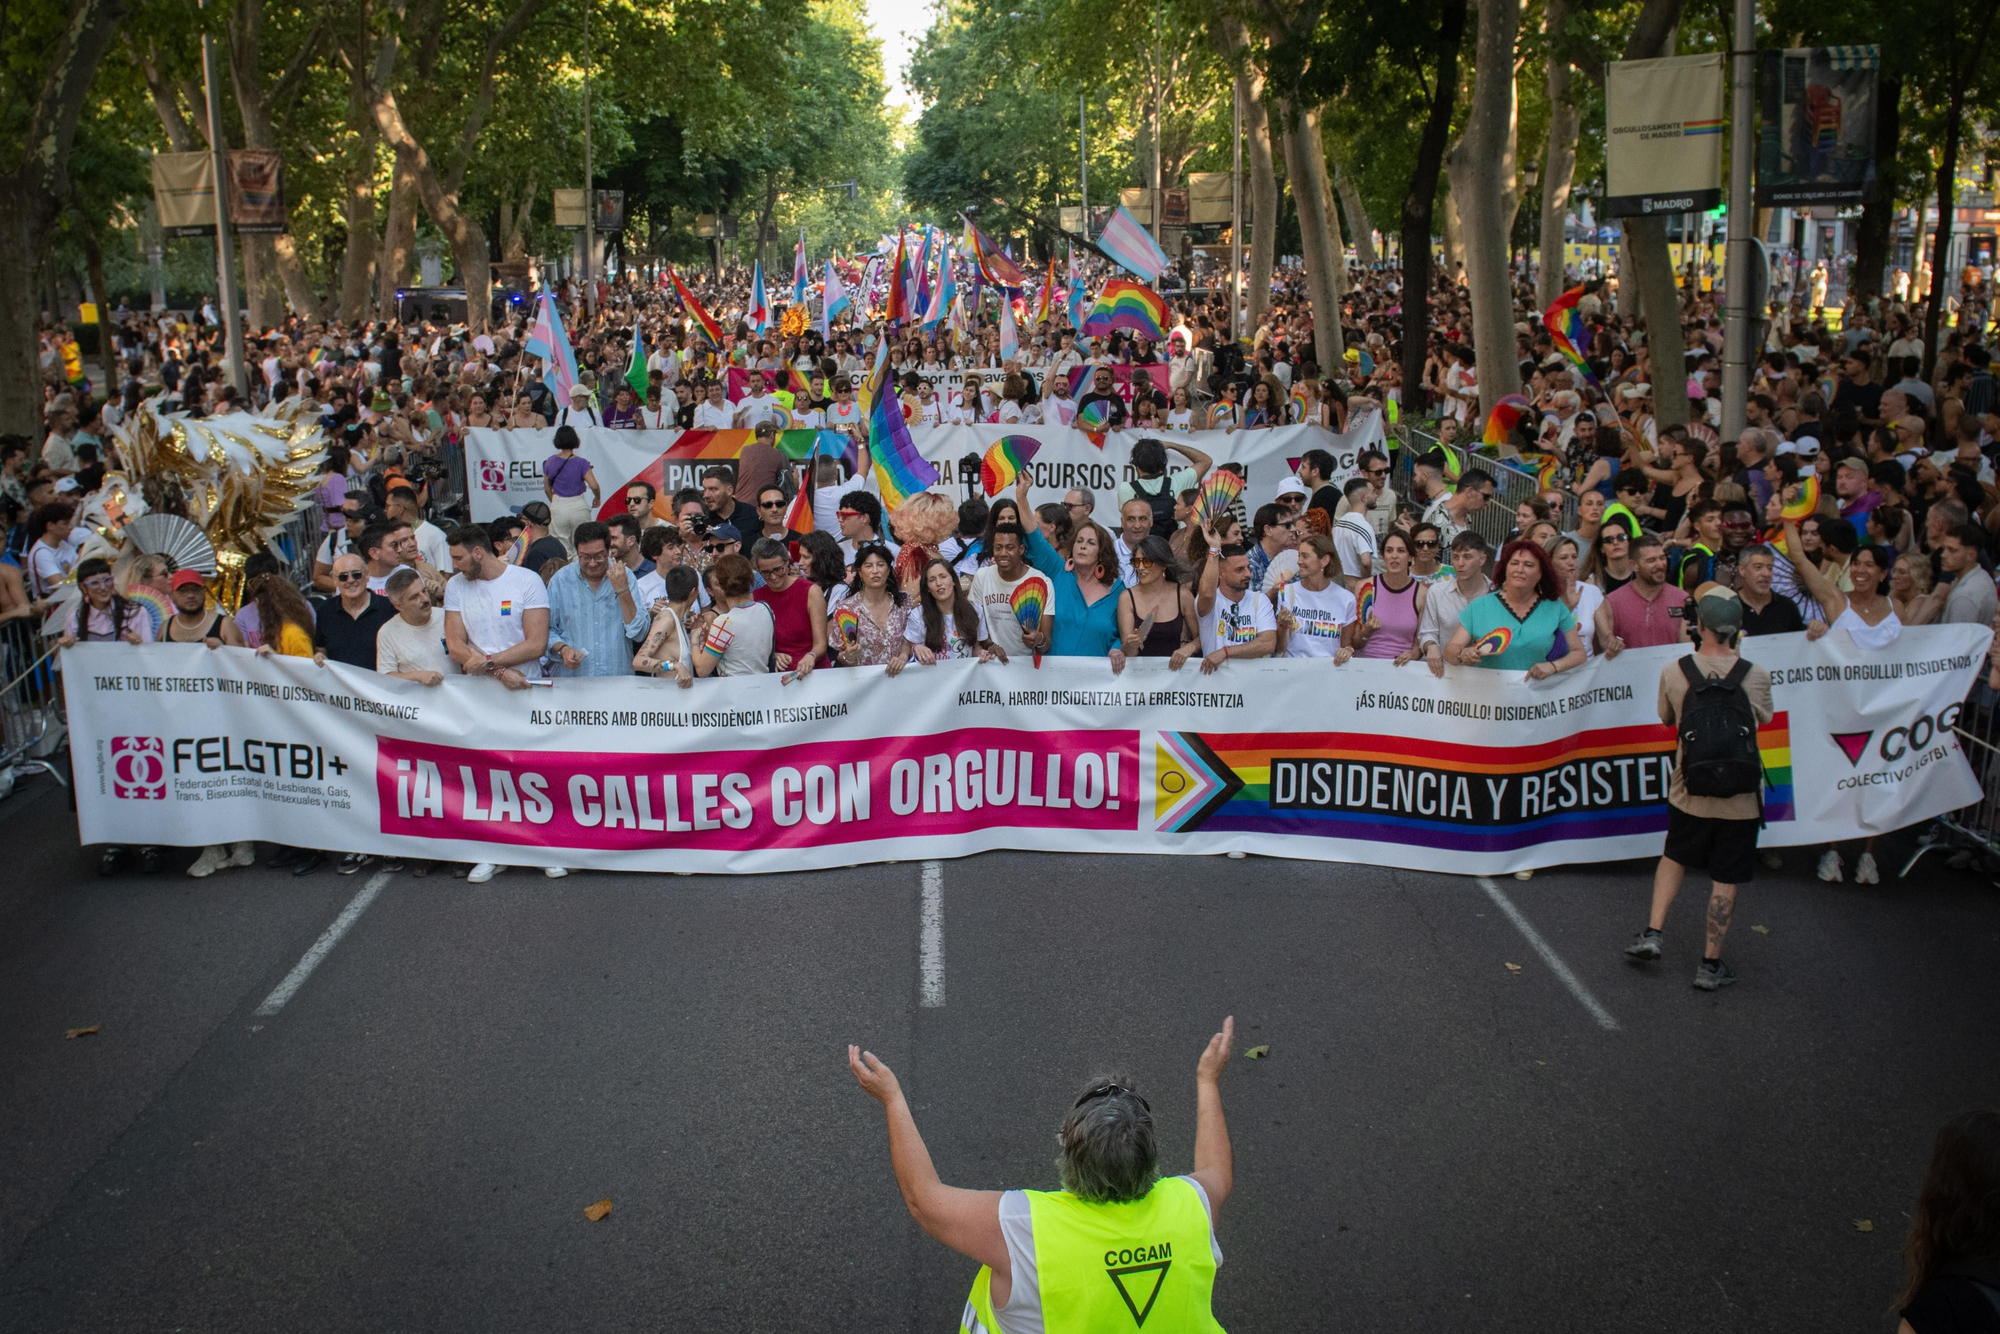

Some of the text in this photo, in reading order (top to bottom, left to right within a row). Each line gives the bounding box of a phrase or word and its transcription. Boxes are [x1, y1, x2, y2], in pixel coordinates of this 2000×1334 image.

[1613, 122, 1681, 134] ORGULLOSAMENTE
[1640, 130, 1681, 140] DE MADRID
[1653, 198, 1694, 210] MADRID
[1292, 606, 1318, 620] MADRID
[1787, 666, 1813, 684] CAIS
[1816, 665, 1841, 681] CON
[1844, 663, 1903, 681] ORGULLU!
[94, 676, 420, 720] TAKE TO THE STREETS WITH PRIDE! DISSENT AND RESISTANCE
[958, 690, 1244, 708] KALERA, HARRO! DISIDENTZIA ETA ERRESISTENTZIA
[1356, 685, 1633, 721] ¡ÁS RÚAS CON ORGULLO! DISIDENCIA E RESISTENCIA
[530, 702, 848, 727] ALS CARRERS AMB ORGULL! DISSIDÈNCIA I RESISTÈNCIA
[172, 736, 349, 781] FELGTBI+
[174, 775, 351, 798] Federación Estatal de Lesbianas, Gais,
[1275, 755, 1674, 820] DISIDENCIA Y RESISTEN
[1837, 765, 1913, 790] COLECTIVO
[174, 787, 351, 810] Trans, Bisexuales, Intersexuales y más
[396, 749, 1121, 832] ¡A LAS CALLES CON ORGULLO!
[1104, 1241, 1172, 1267] COGAM
